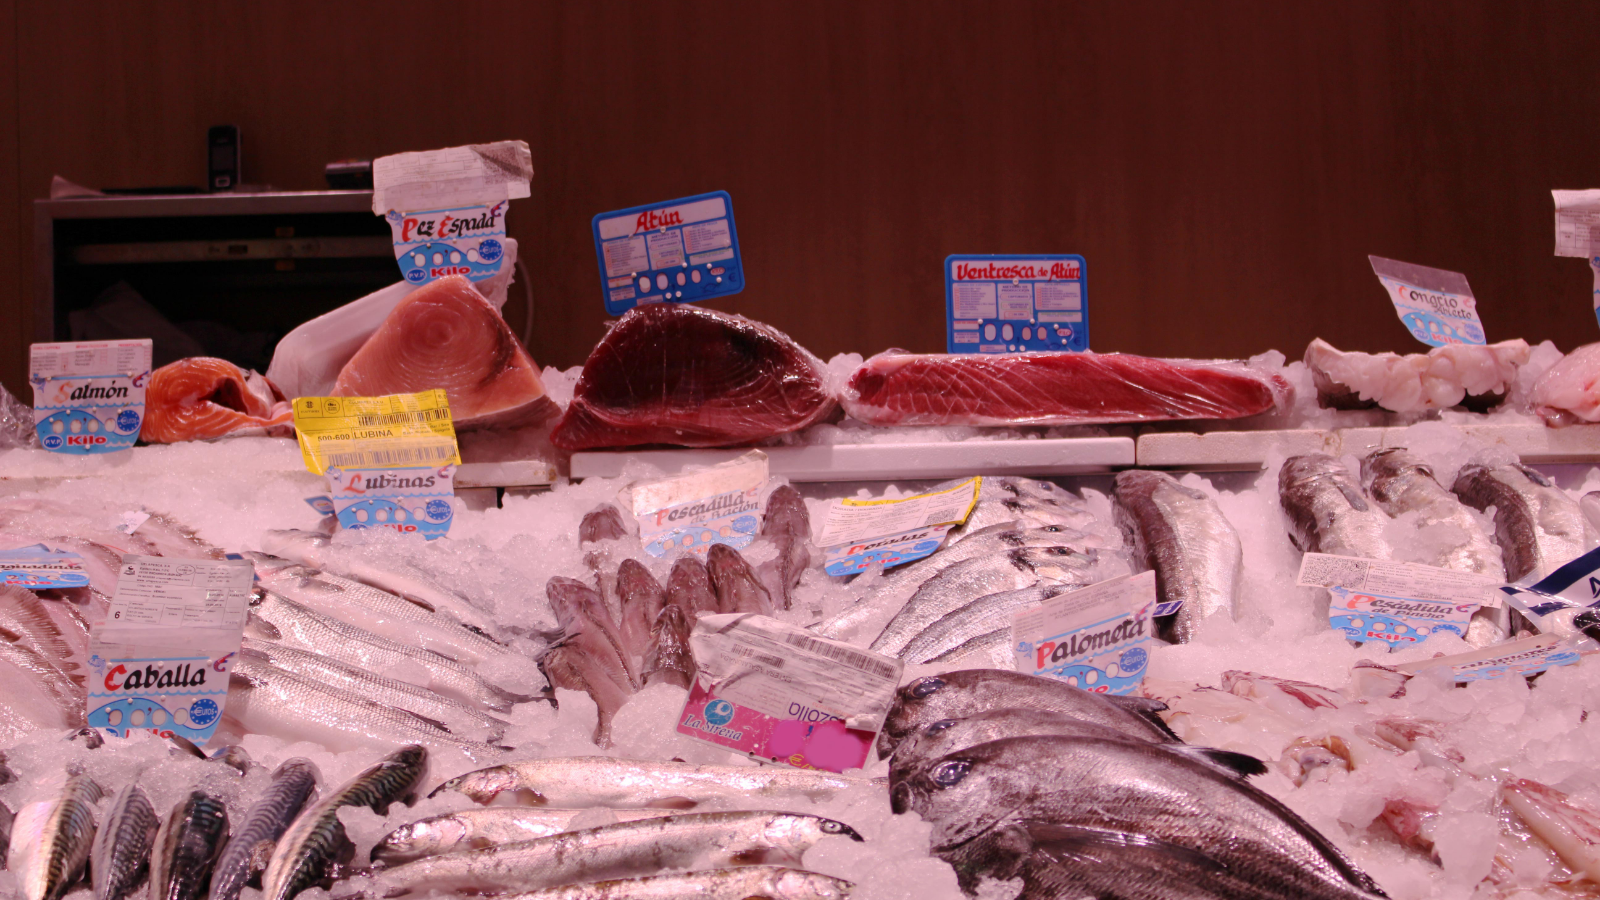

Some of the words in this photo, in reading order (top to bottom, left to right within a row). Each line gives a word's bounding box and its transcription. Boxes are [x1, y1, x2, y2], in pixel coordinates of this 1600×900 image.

[402, 218, 435, 242] Pez
[437, 213, 495, 238] Espada
[635, 209, 684, 235] Atún
[430, 266, 471, 277] Kilo
[957, 263, 1036, 280] Ventresca
[1037, 267, 1049, 277] de
[1049, 262, 1081, 281] Atún
[1399, 285, 1458, 308] Congrio
[53, 380, 128, 404] Salmón
[67, 435, 107, 446] Kilo
[354, 430, 393, 439] LUBINA
[343, 473, 436, 493] Lubinas
[656, 492, 745, 527] Pescadilla
[711, 501, 759, 519] Ración
[114, 611, 121, 619] 6
[1346, 595, 1453, 614] Pescadilla
[1037, 619, 1147, 669] Palometa
[104, 663, 206, 691] Caballa
[683, 714, 701, 728] La
[702, 720, 743, 741] Sirena
